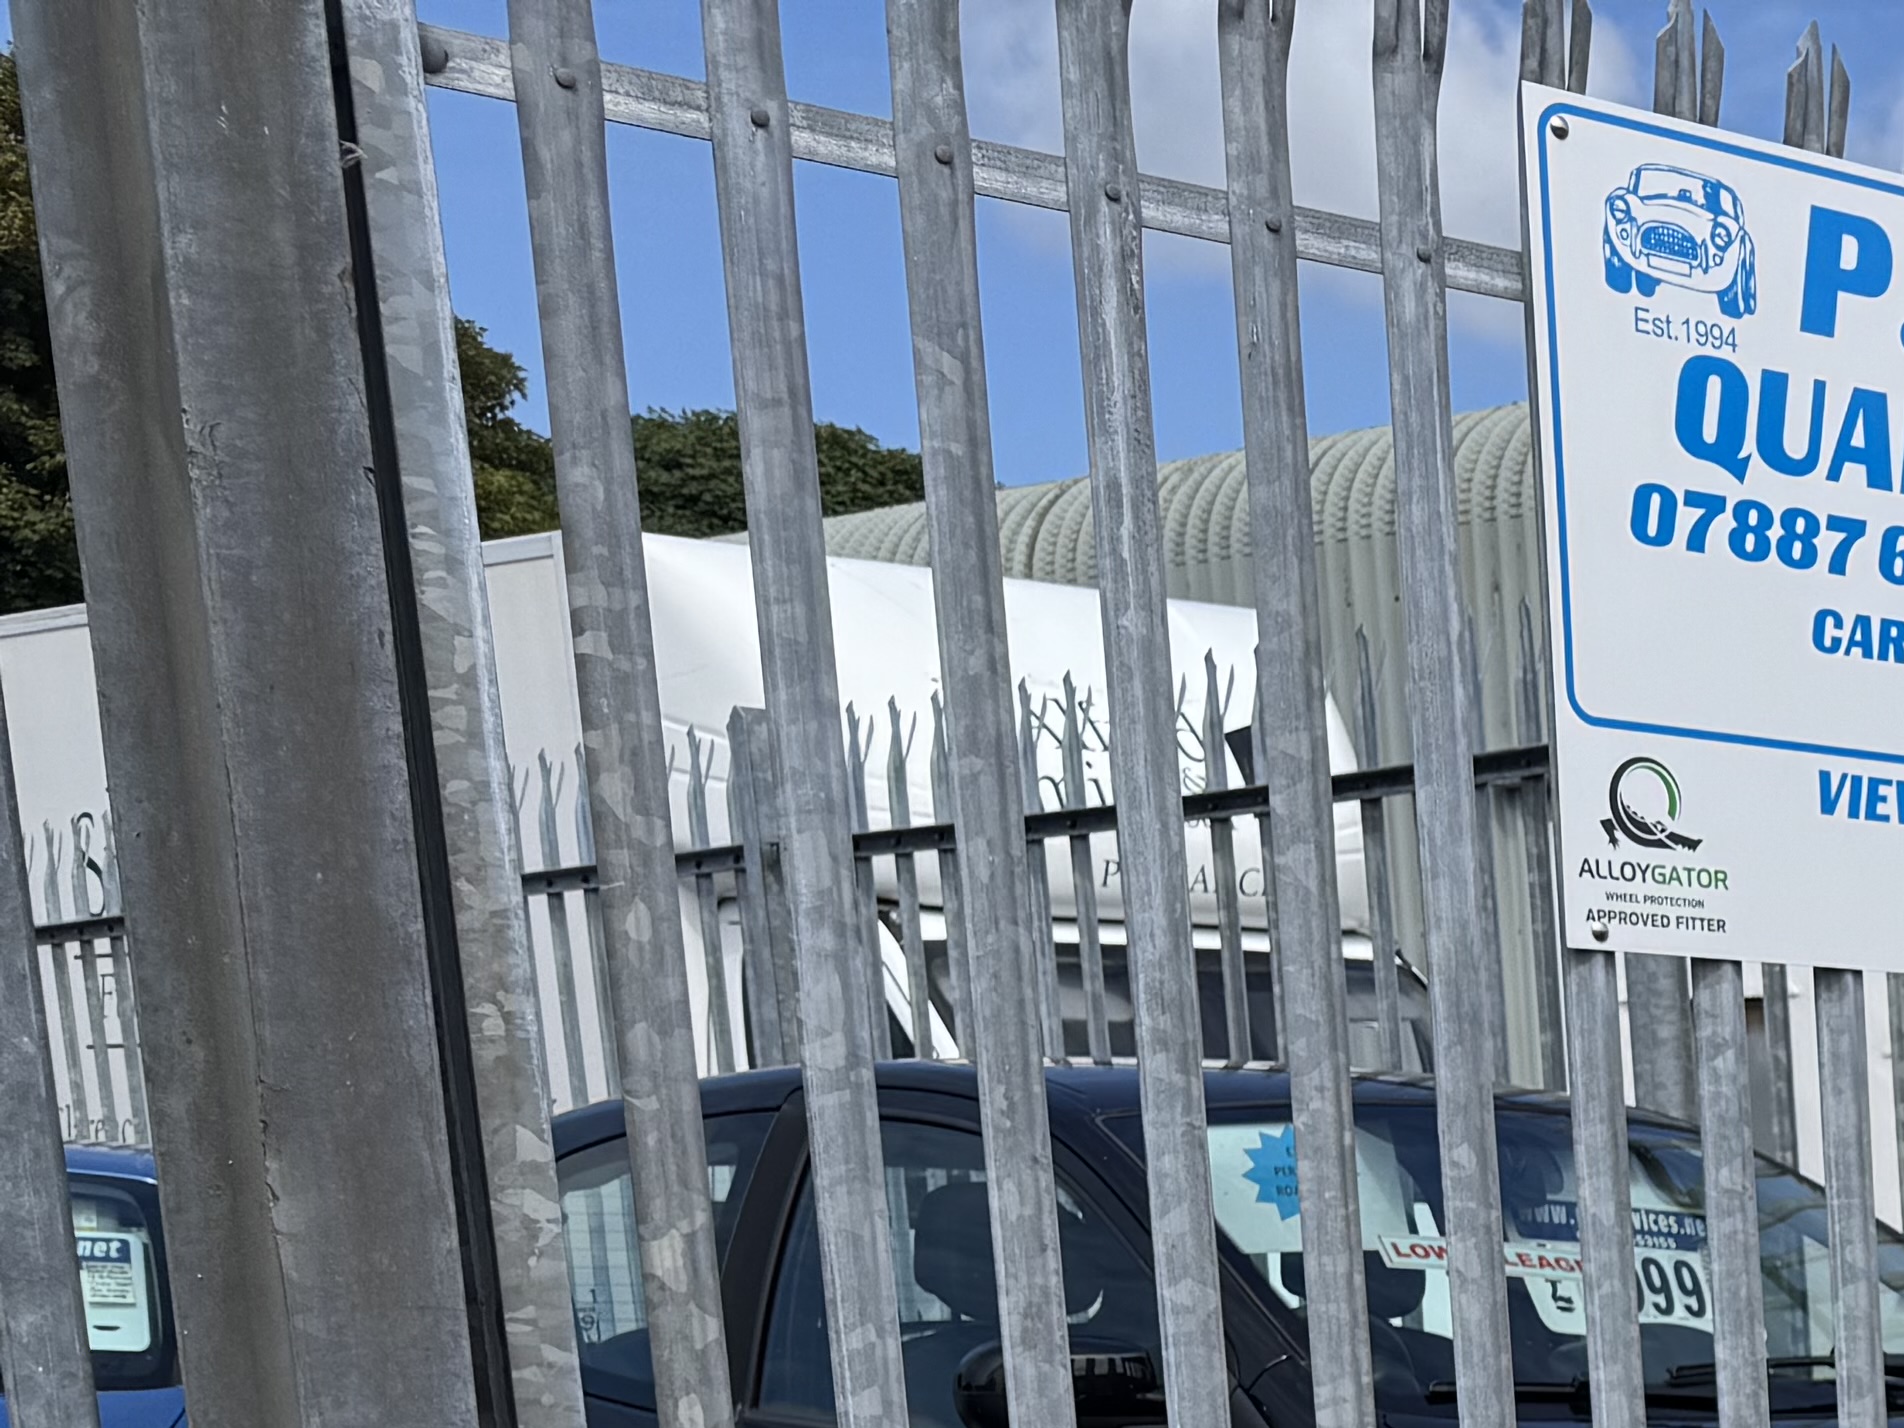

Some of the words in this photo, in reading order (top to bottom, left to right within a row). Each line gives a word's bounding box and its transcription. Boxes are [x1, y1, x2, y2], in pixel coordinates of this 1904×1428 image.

[1633, 304, 1740, 354] Est.1994
[1630, 481, 1868, 577] 07887
[1578, 857, 1729, 891] ALLOYGATOR
[1605, 891, 1642, 905] WHEEL
[1643, 893, 1705, 909] PROTECTION
[1585, 907, 1671, 929] APPROVED
[1675, 915, 1727, 933] FITTER
